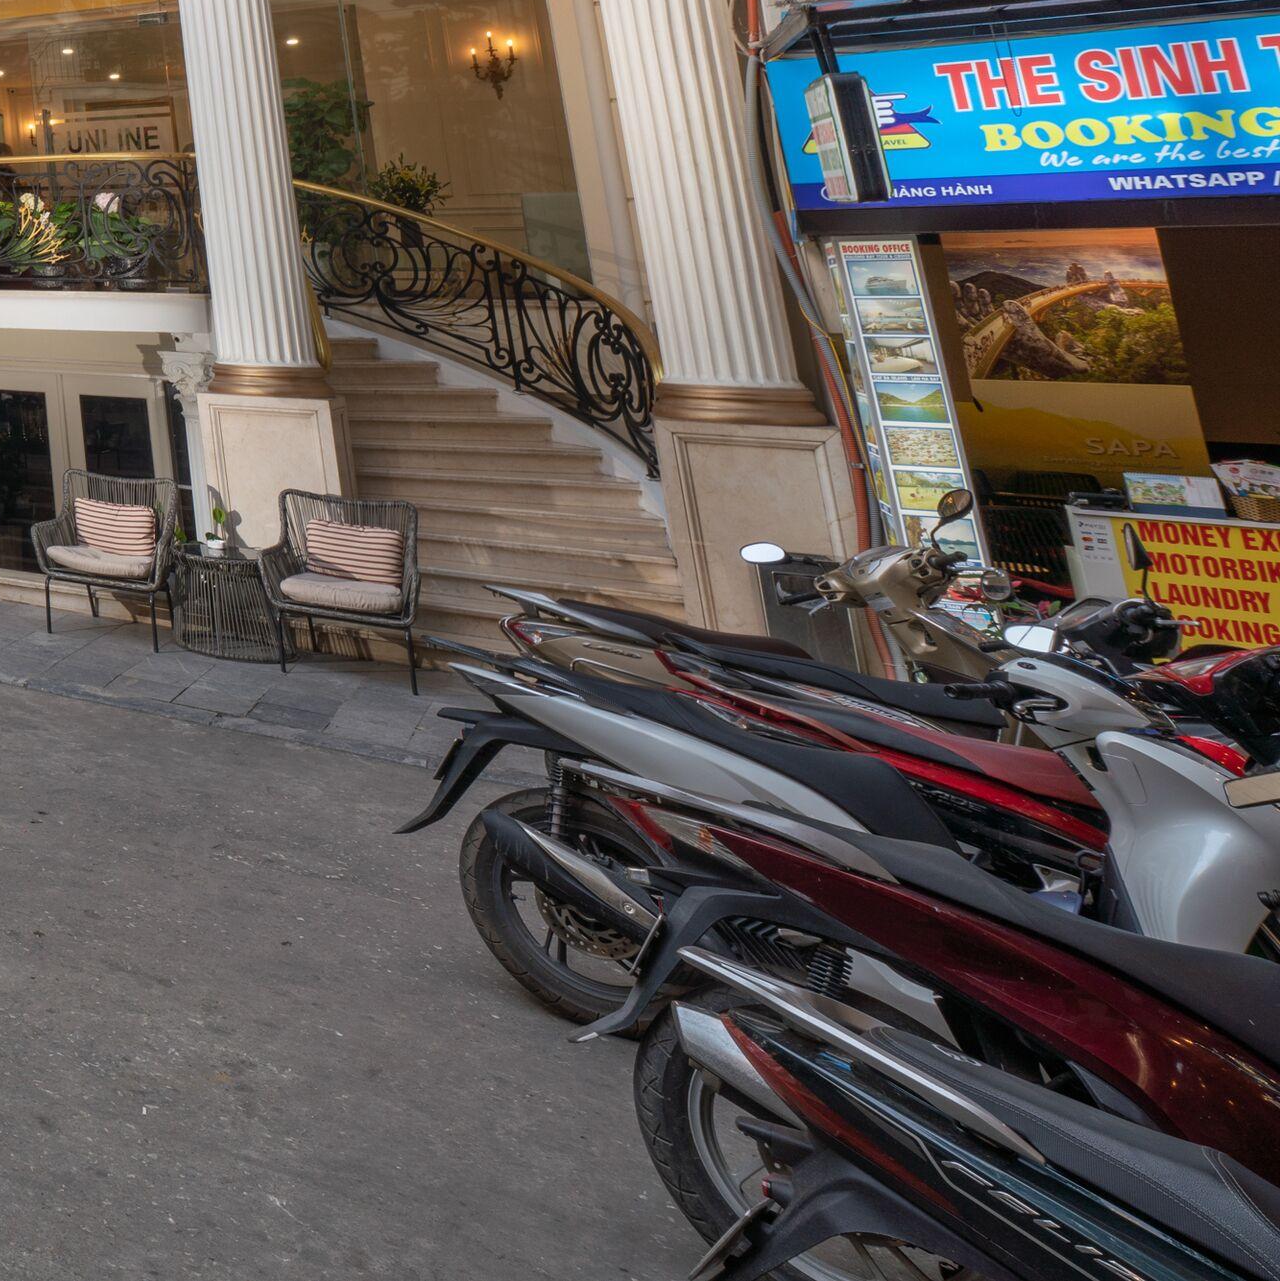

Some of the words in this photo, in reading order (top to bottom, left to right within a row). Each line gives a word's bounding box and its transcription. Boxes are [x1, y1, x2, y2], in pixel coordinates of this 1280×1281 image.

[933, 53, 1065, 112] THE
[1074, 37, 1251, 103] SINH
[979, 106, 1280, 152] BOOKING
[1040, 151, 1083, 167] We
[1092, 152, 1147, 166] are
[1154, 143, 1205, 164] the
[1216, 139, 1280, 160] best
[941, 183, 993, 197] HÀNH
[1108, 171, 1266, 191] WHATSAPP
[842, 243, 880, 254] BOOKING
[882, 243, 911, 253] OFFICE
[1085, 437, 1179, 459] SAPA
[1137, 521, 1231, 548] MONEY
[1240, 528, 1280, 552] EX
[1151, 582, 1270, 614] LAUNDRY
[1173, 615, 1280, 646] OOKING
